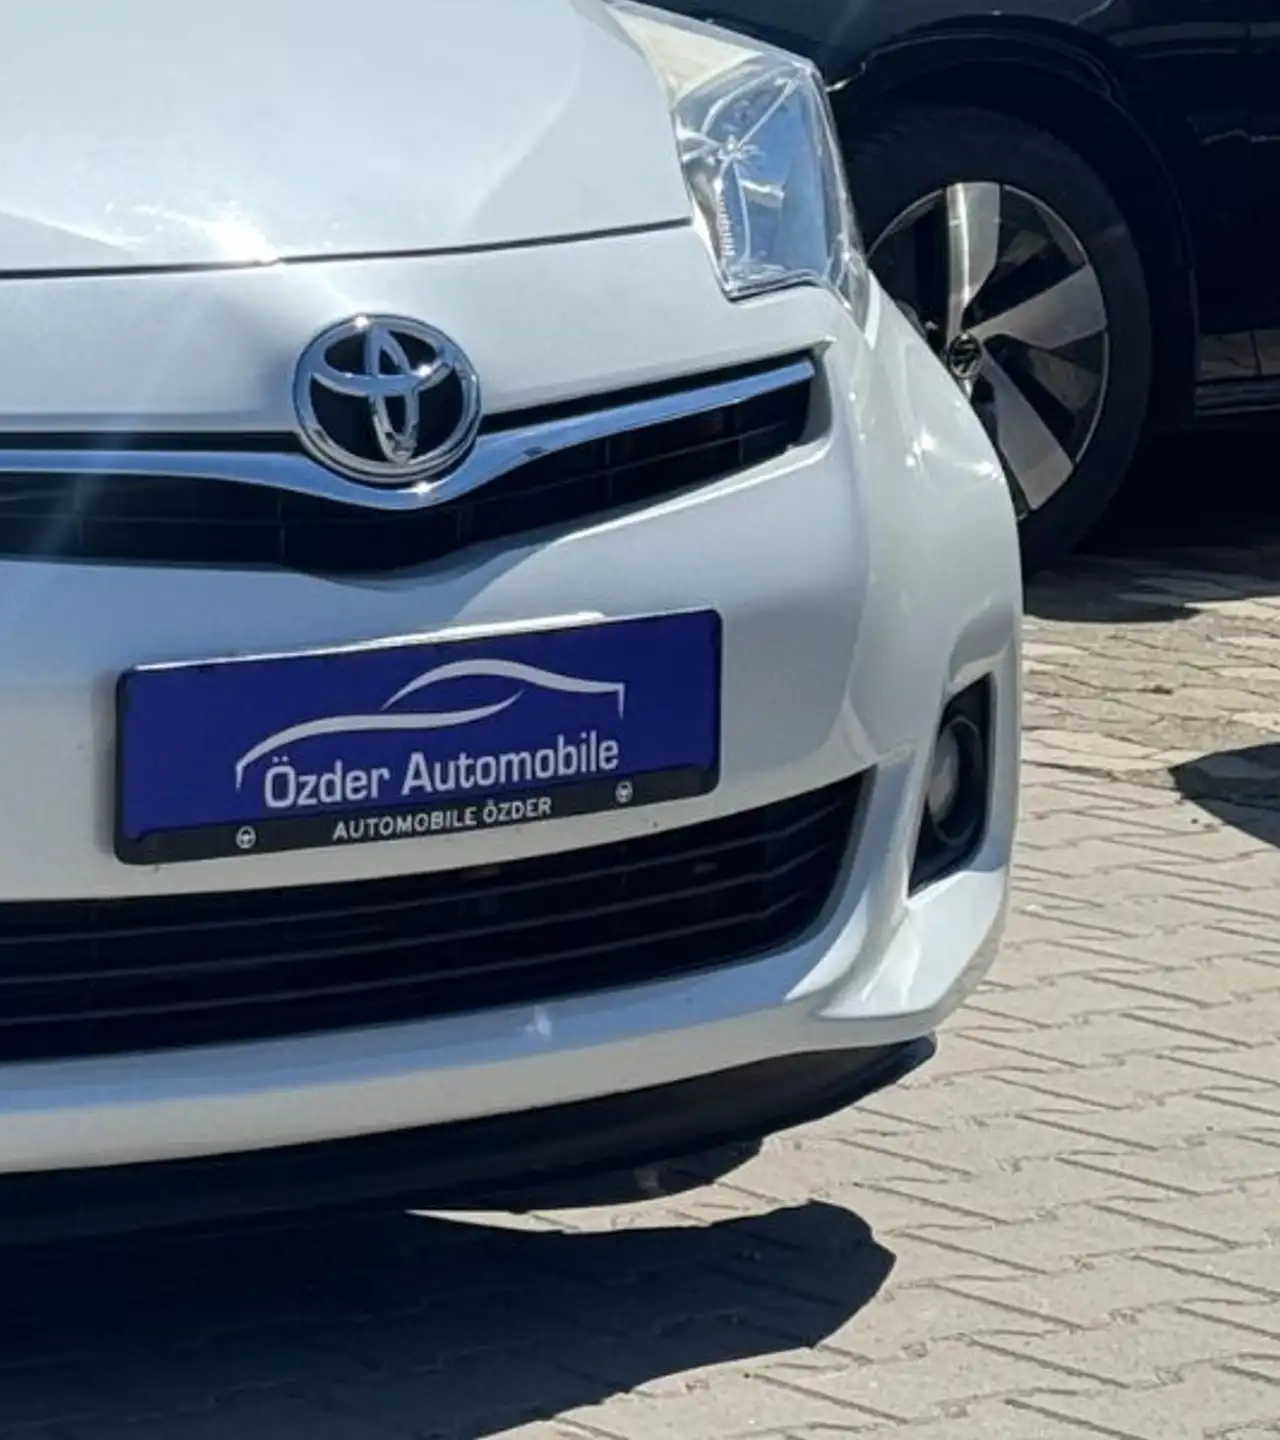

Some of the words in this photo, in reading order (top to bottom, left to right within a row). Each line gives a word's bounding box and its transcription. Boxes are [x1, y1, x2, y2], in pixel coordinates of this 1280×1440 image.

[264, 755, 391, 808] Özder
[401, 730, 619, 796] Automobile
[333, 805, 477, 841] AUTOMOBILE
[483, 796, 552, 825] ÖZDER
